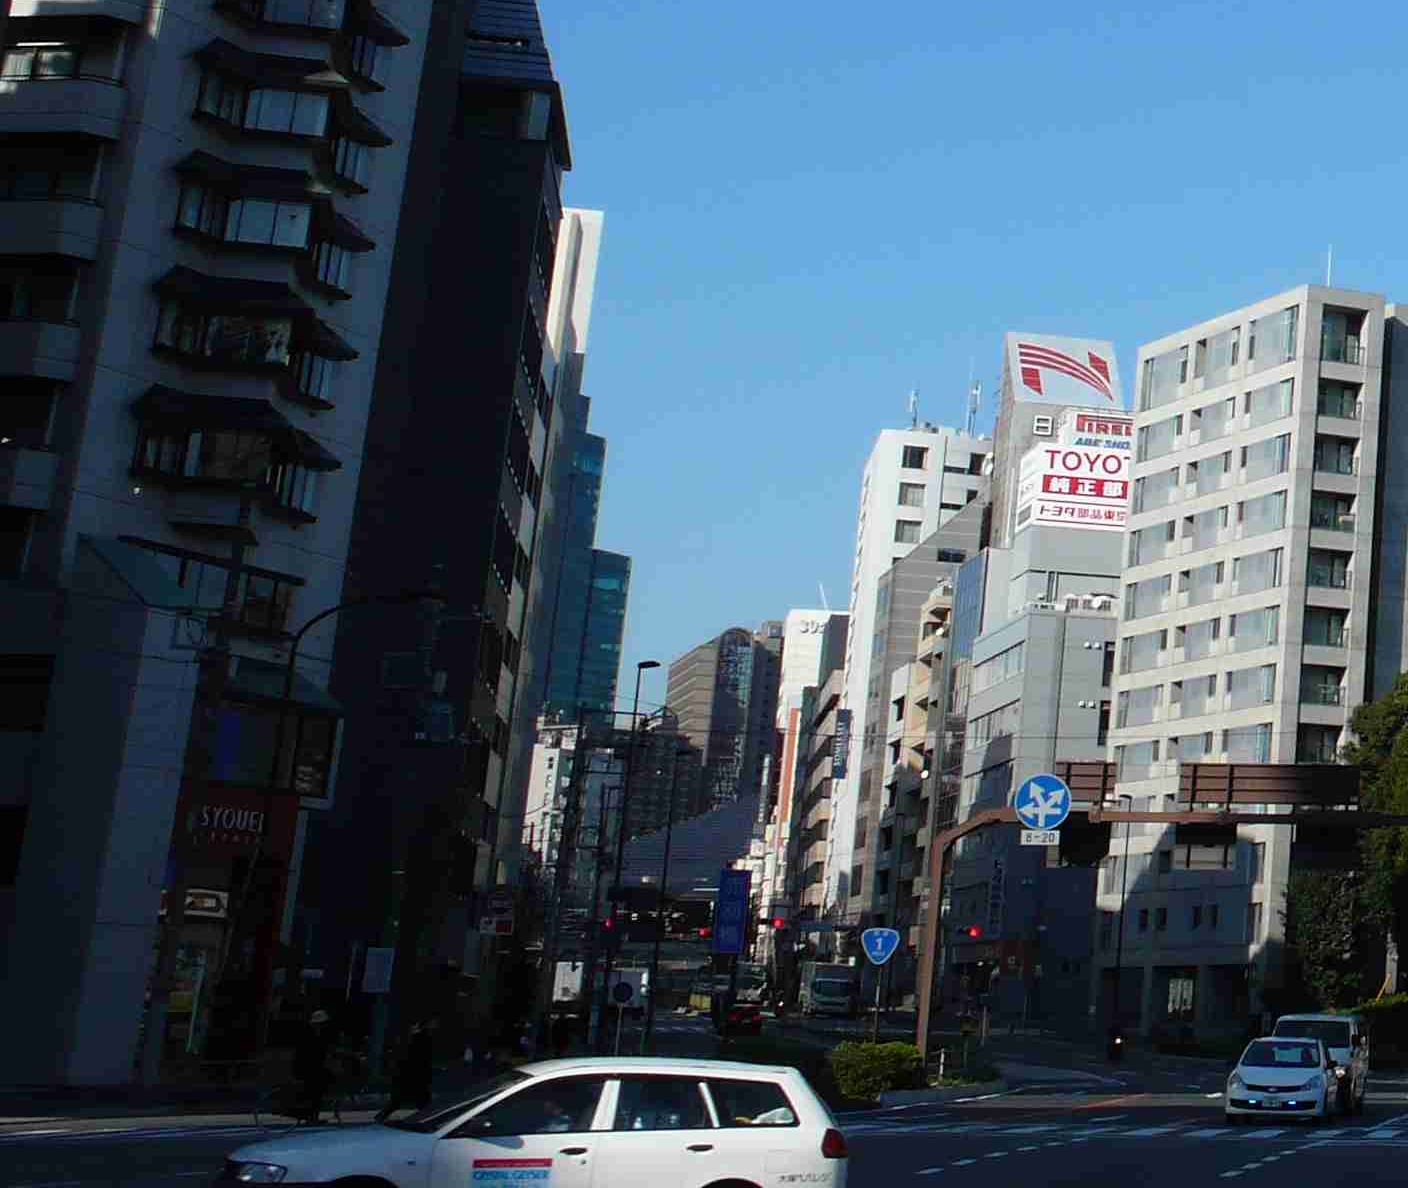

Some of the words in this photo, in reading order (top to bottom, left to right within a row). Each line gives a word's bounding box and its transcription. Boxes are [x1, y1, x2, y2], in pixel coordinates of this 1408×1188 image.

[1044, 449, 1131, 475] TOYO
[1048, 476, 1125, 498] 純正部
